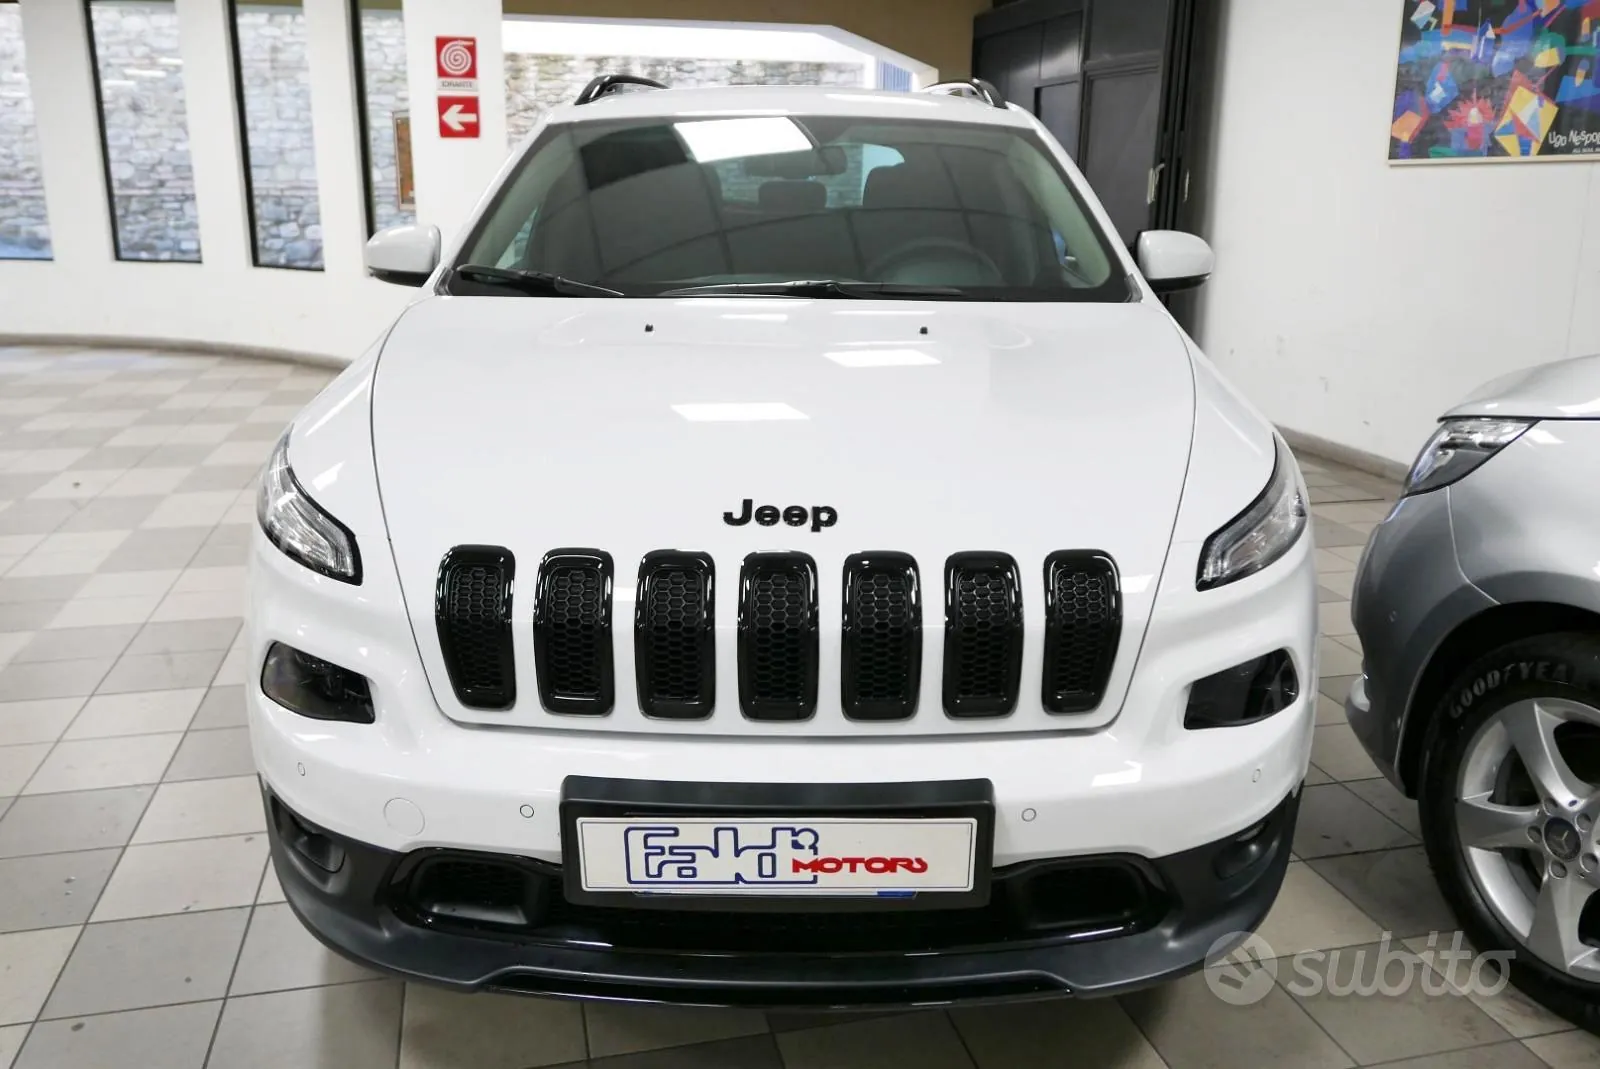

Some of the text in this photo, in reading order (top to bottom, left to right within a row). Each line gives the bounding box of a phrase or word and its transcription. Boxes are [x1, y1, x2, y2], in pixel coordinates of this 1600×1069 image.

[1548, 131, 1567, 148] Ugo
[723, 498, 838, 532] Jeep
[792, 857, 928, 873] MOTORS
